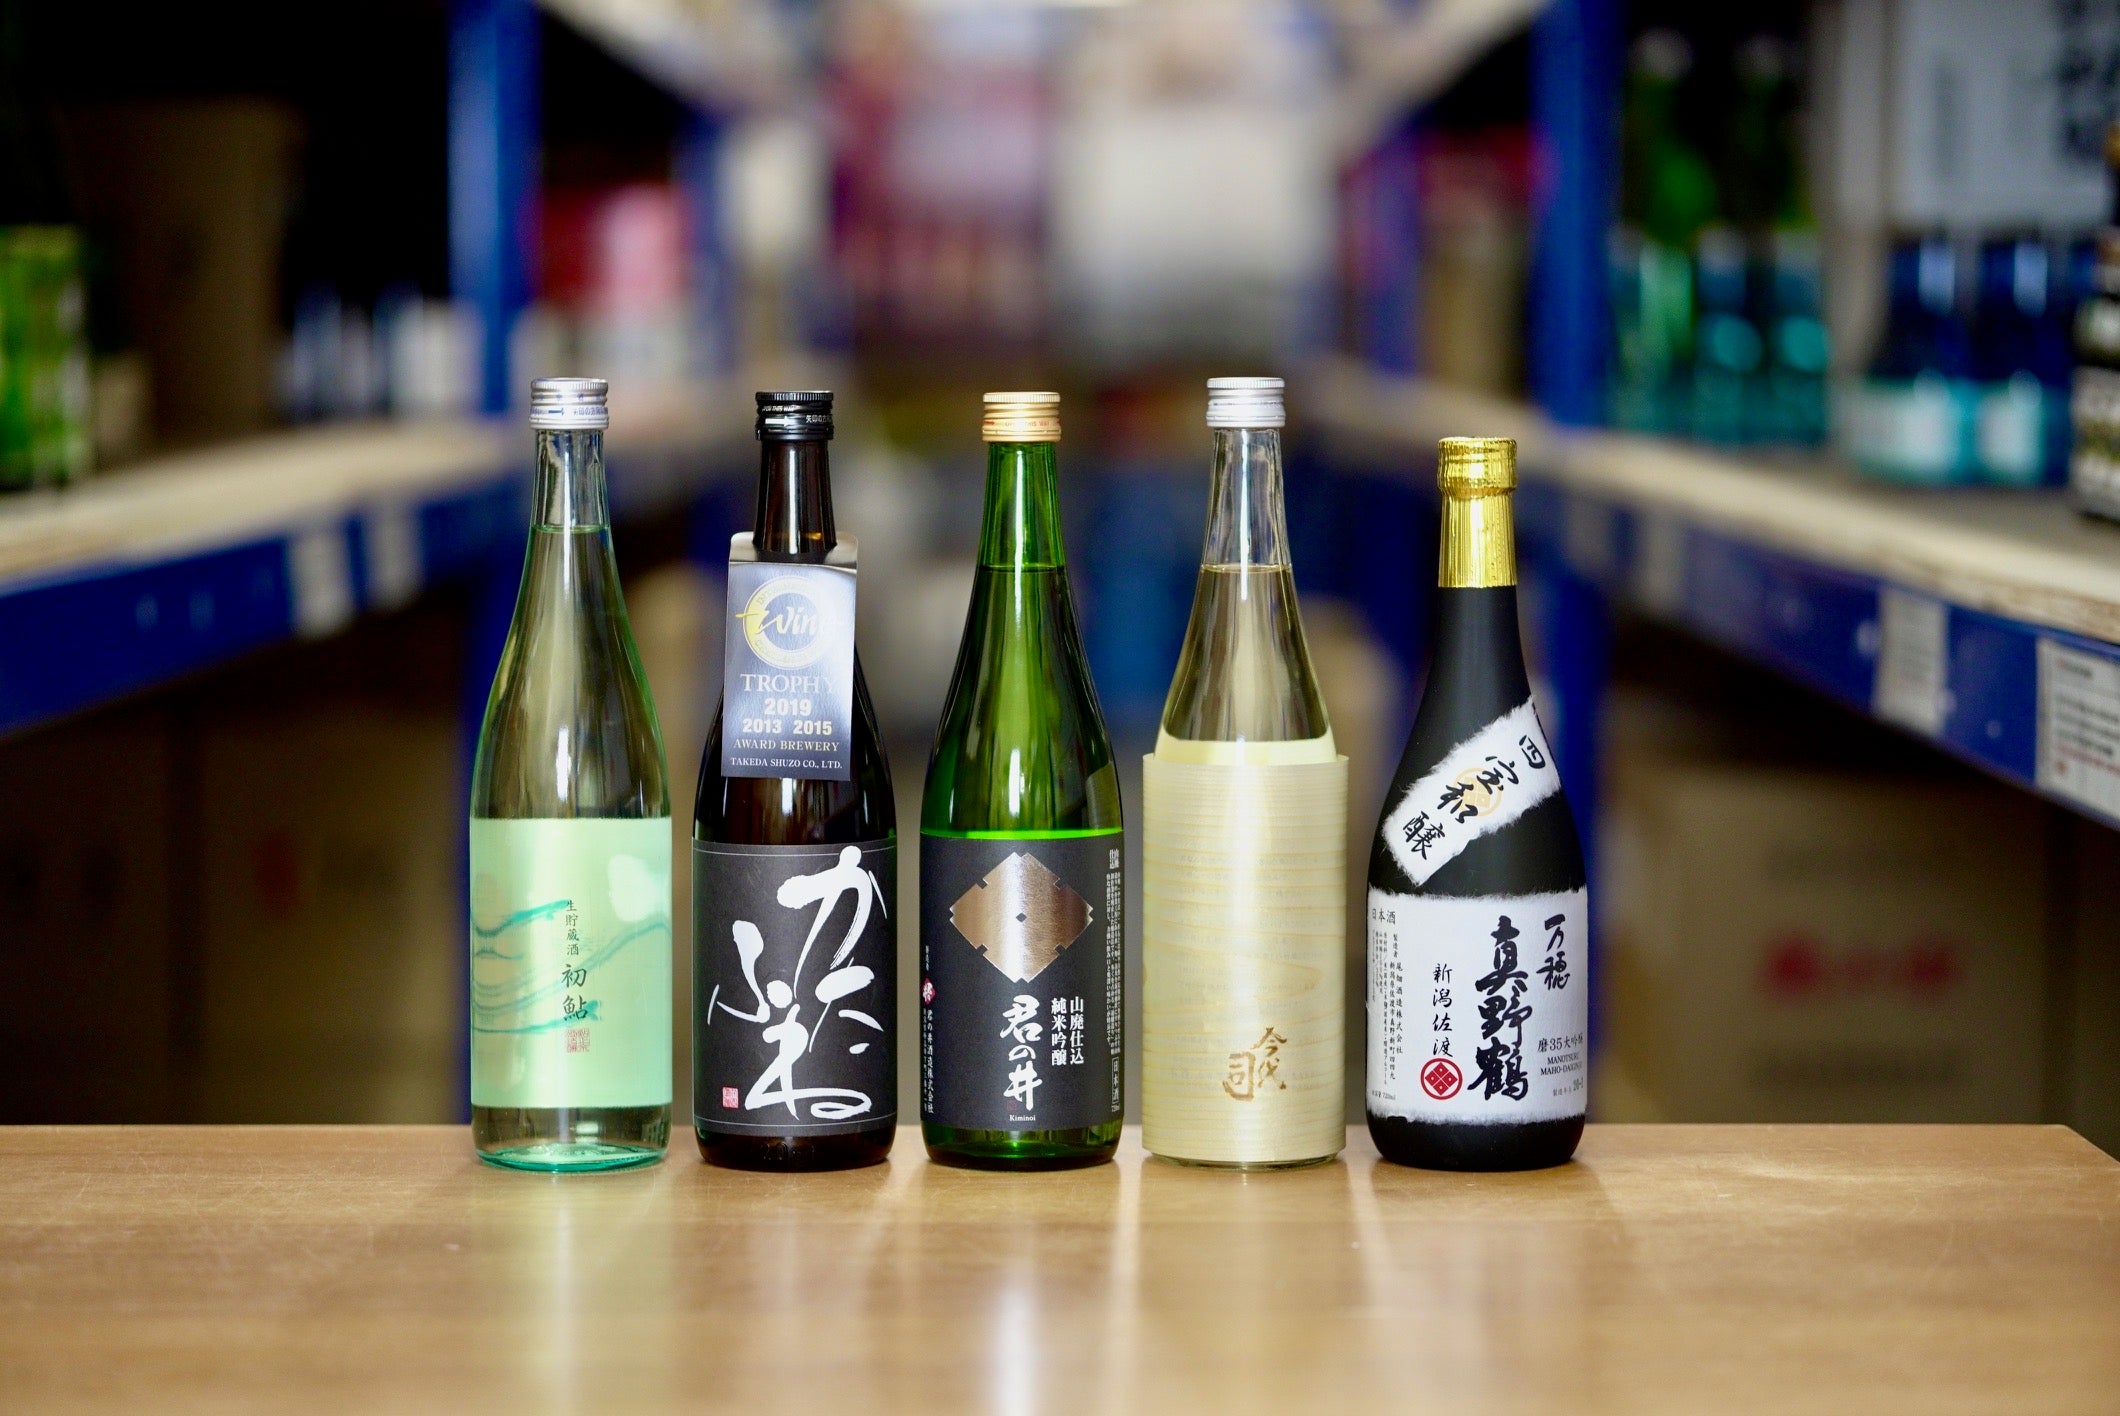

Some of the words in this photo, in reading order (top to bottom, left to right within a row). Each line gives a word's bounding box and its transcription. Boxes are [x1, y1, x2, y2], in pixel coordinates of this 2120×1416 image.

[740, 673, 837, 694] TROPHY
[764, 698, 813, 716] 2019
[733, 739, 776, 750] AWARD
[780, 741, 840, 752] BREWERY
[743, 719, 782, 734] 2013
[793, 720, 833, 735] 2015
[730, 757, 768, 767] TAKEDA
[770, 759, 801, 767] SHUZO
[803, 760, 820, 769] CO.,
[821, 760, 843, 769] LTD.
[565, 899, 580, 957] 生貯蔵酒
[1371, 908, 1396, 925] 日本酒
[561, 963, 589, 1022] 初鮎
[1432, 963, 1454, 1058] 新潟佐渡
[1467, 915, 1533, 1102] 真野鶴
[1051, 997, 1067, 1066] 純米吟醸
[1070, 996, 1084, 1065] 山廃仕込
[999, 994, 1043, 1111] 君の井
[1009, 1114, 1036, 1122] Kiminoi
